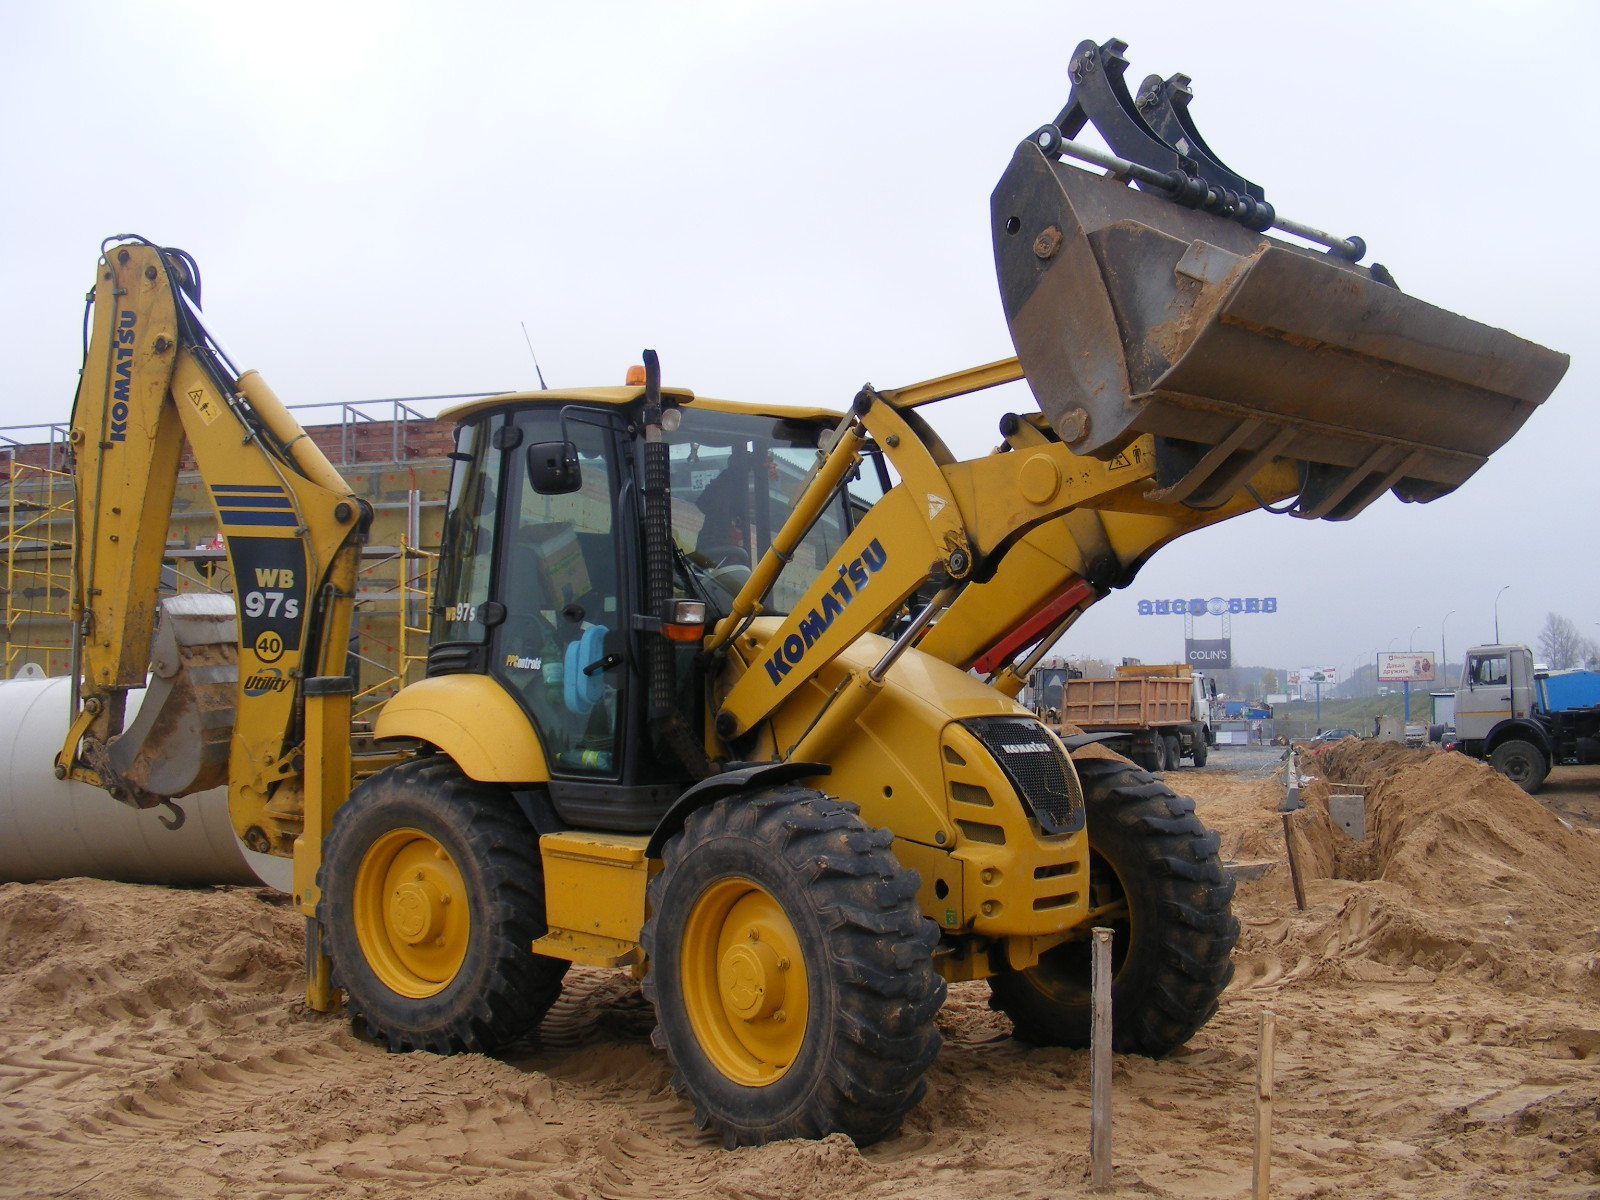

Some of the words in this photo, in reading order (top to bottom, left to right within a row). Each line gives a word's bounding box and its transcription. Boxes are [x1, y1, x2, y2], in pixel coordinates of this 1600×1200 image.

[110, 310, 138, 442] KOMATSU
[255, 567, 295, 589] WB
[764, 537, 887, 687] KOMATSU
[257, 638, 281, 654] 40
[1189, 649, 1228, 660] COLIN'S
[244, 675, 292, 693] Utility
[1001, 741, 1051, 754] KOMATSU
